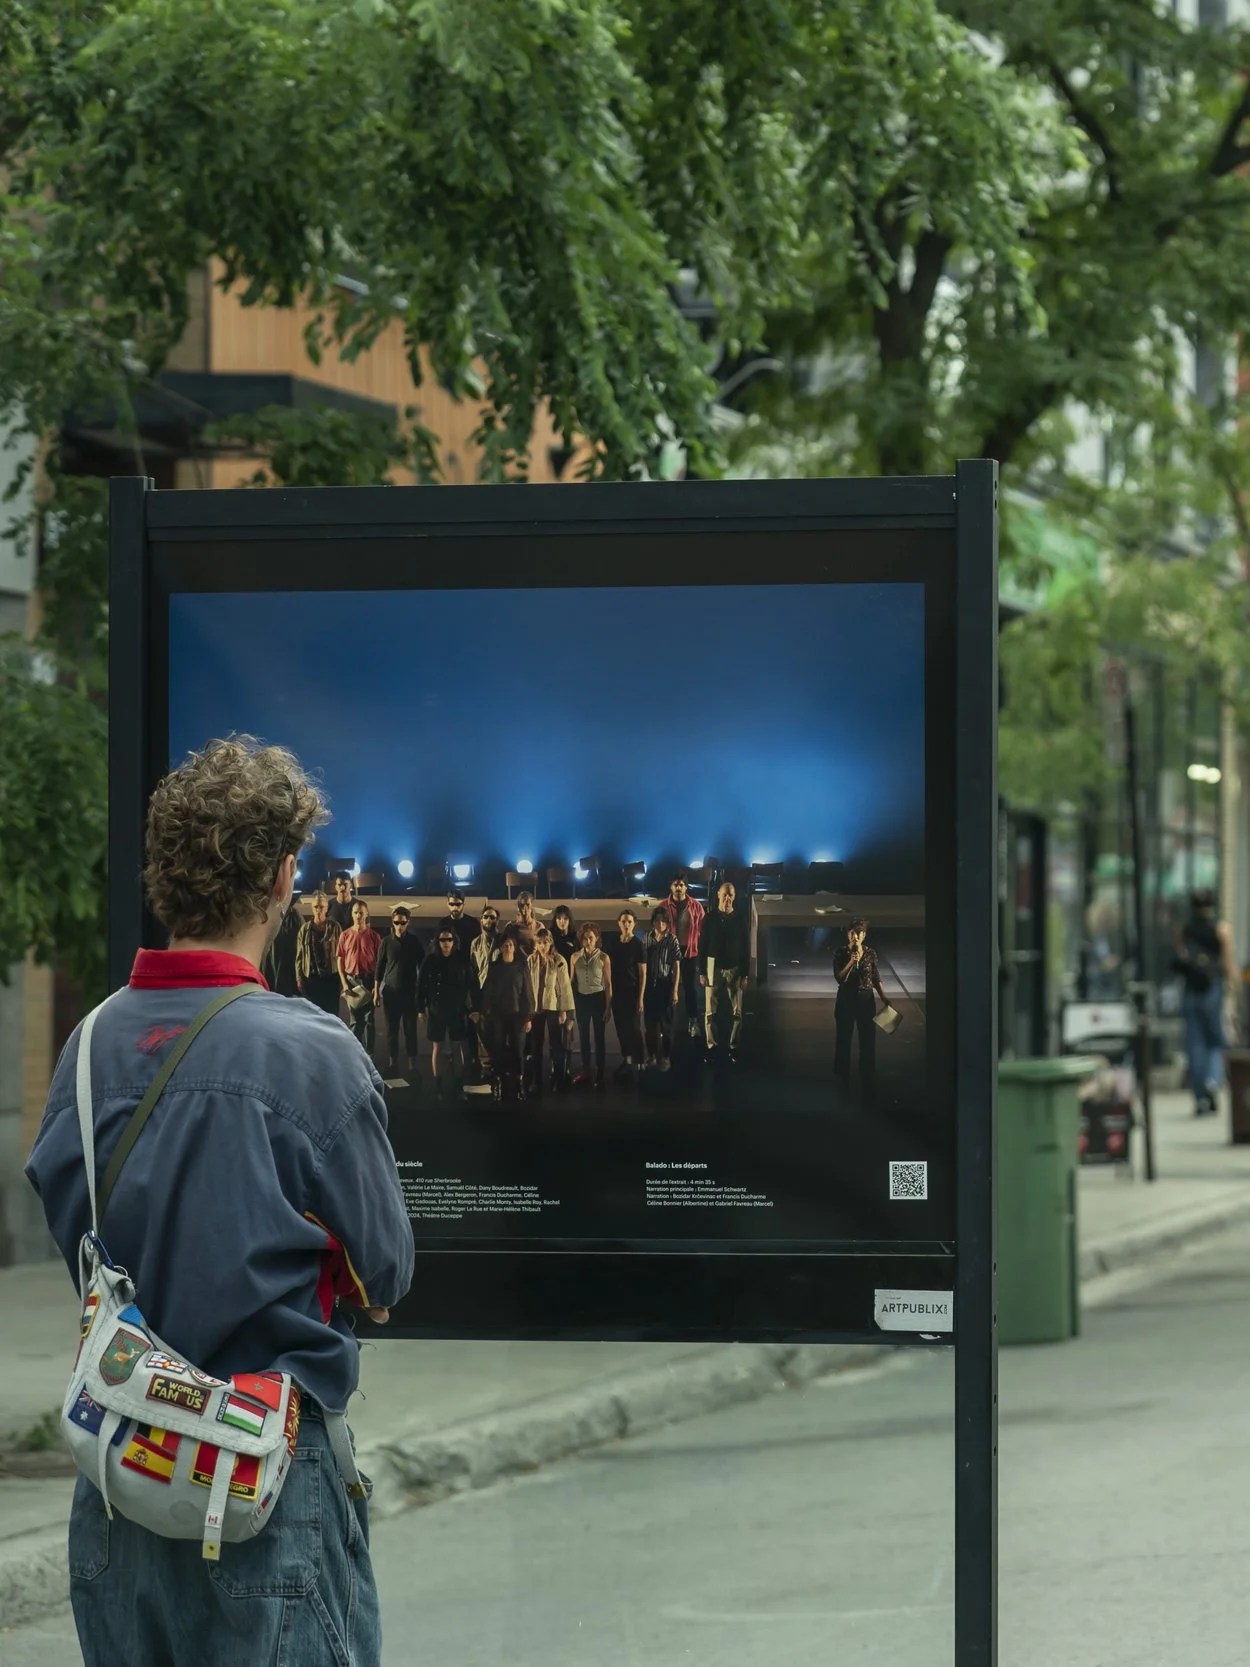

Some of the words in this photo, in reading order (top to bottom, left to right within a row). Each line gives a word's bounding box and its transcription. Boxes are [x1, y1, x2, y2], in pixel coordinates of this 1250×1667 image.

[683, 1162, 708, 1170] départs
[881, 1303, 944, 1314] ARTPUBLIX
[169, 1381, 201, 1397] WORLD
